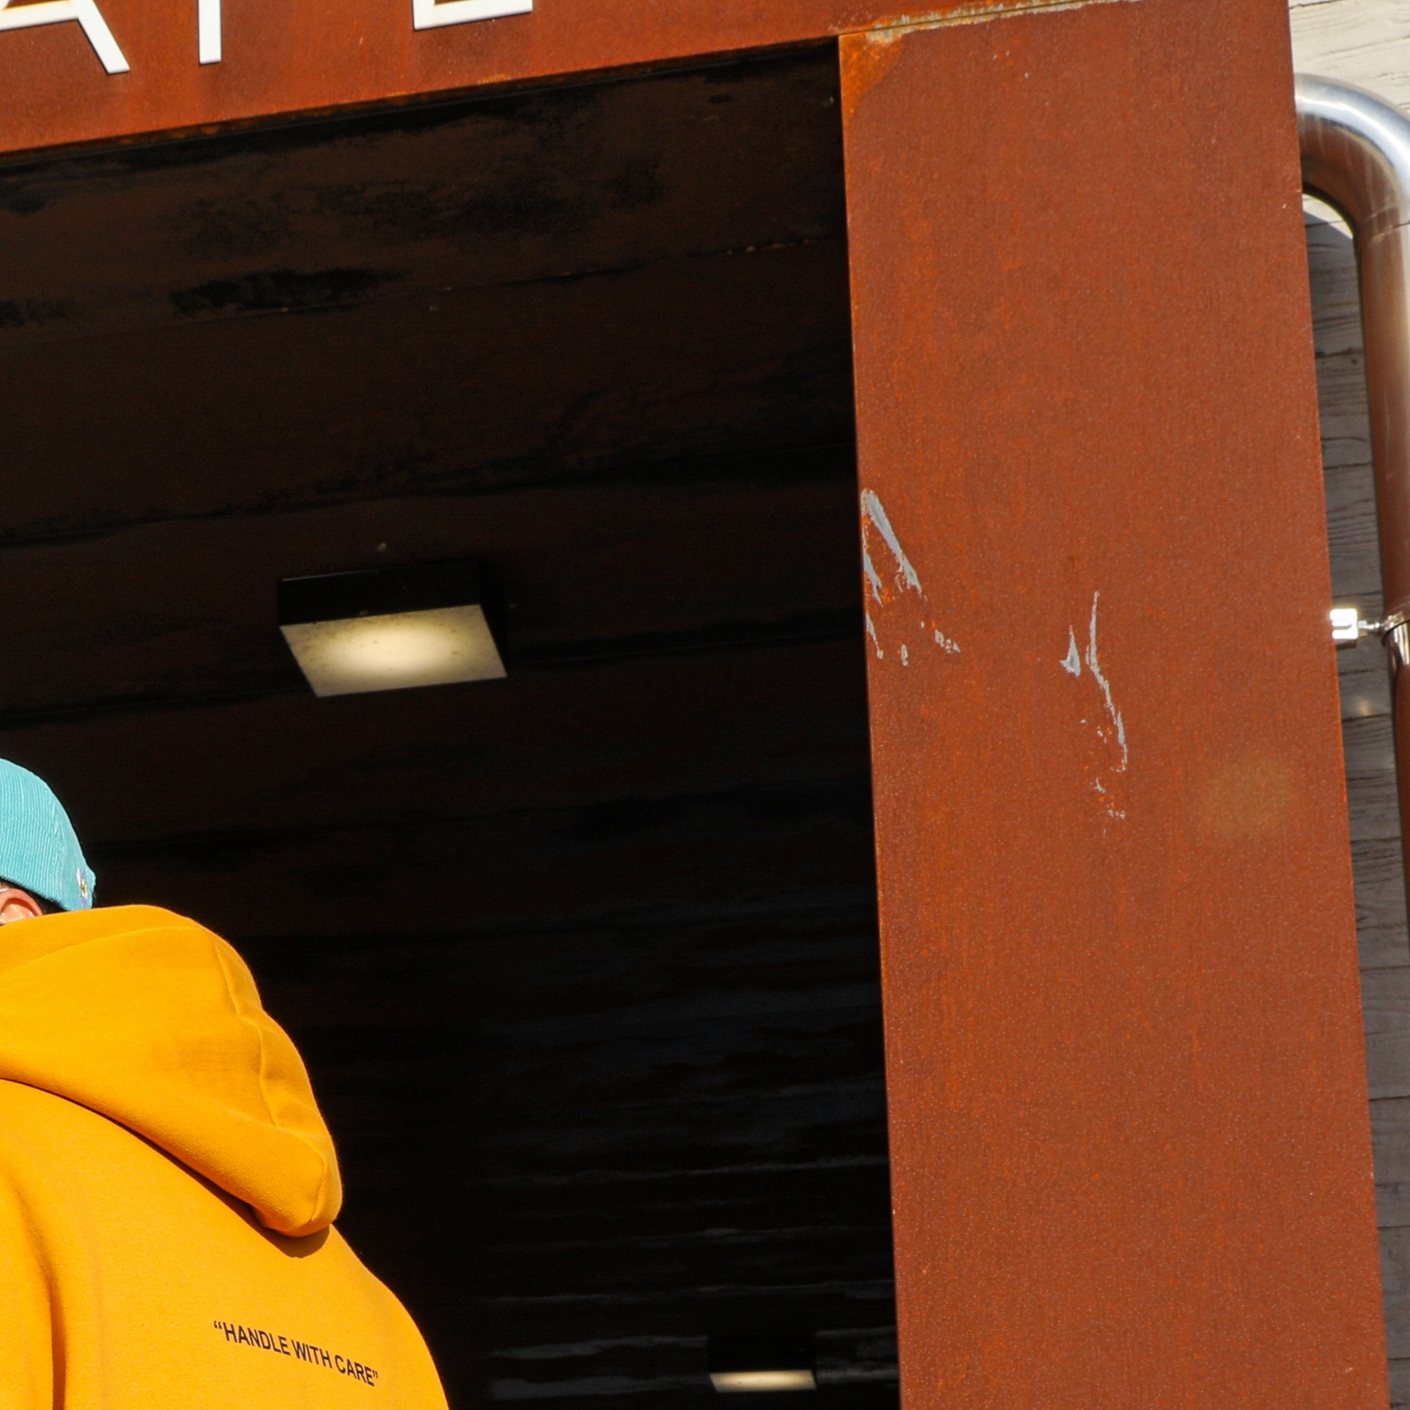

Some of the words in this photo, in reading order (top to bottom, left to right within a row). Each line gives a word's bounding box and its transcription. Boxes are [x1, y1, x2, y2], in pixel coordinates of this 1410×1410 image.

[213, 1320, 291, 1356] “HANDLE
[291, 1339, 333, 1369] WITH
[335, 1355, 379, 1387] CARE”
